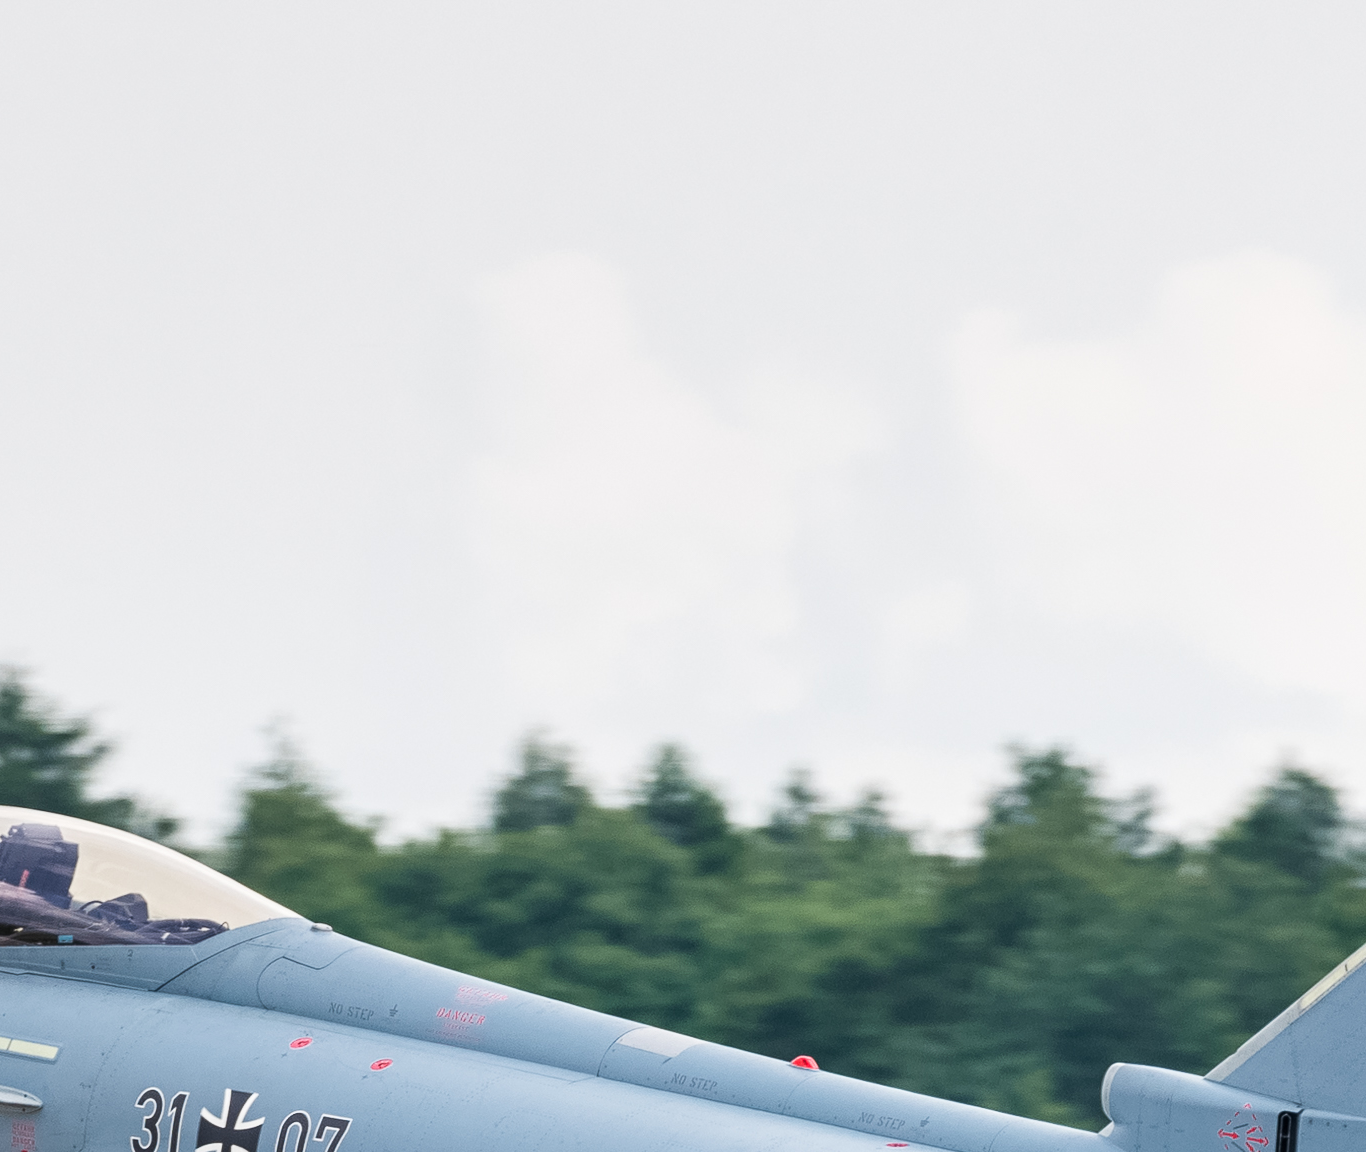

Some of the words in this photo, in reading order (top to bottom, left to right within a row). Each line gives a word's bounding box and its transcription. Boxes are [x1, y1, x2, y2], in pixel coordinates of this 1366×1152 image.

[328, 1002, 343, 1015] NO
[347, 1006, 375, 1021] STEP
[436, 1007, 486, 1025] DANGER
[671, 1073, 687, 1085] NO
[689, 1077, 718, 1091] STEP
[858, 1112, 875, 1124] NO
[877, 1115, 906, 1130] STEP
